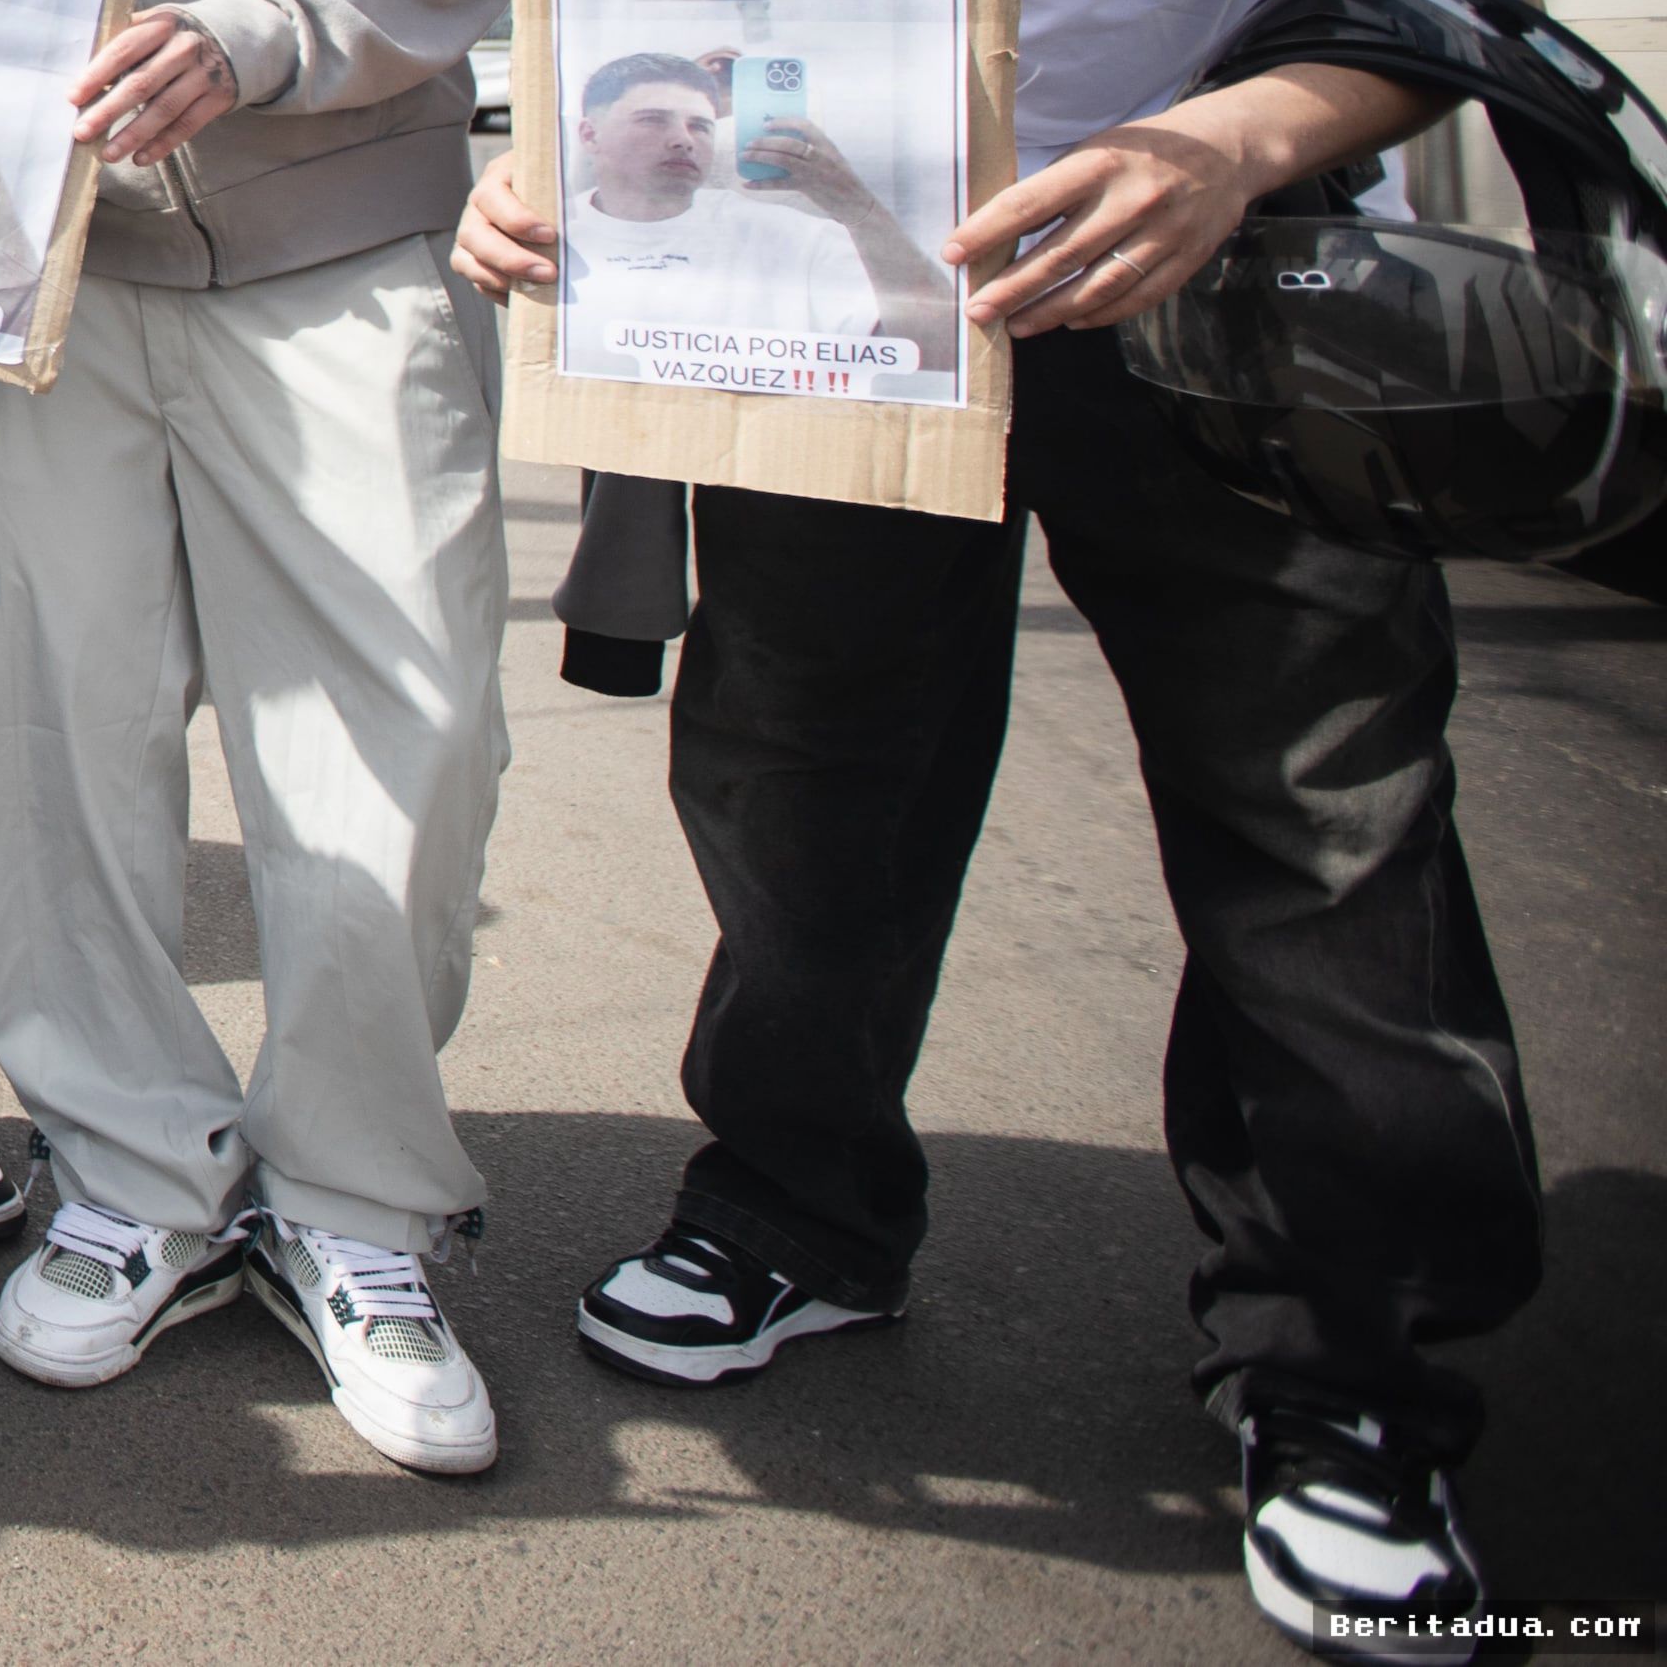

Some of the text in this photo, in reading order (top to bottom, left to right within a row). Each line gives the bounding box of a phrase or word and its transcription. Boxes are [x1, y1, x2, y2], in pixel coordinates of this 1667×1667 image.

[616, 328, 898, 366] JUSTICIA POR ELIAS
[652, 359, 786, 389] VAZQUEZ
